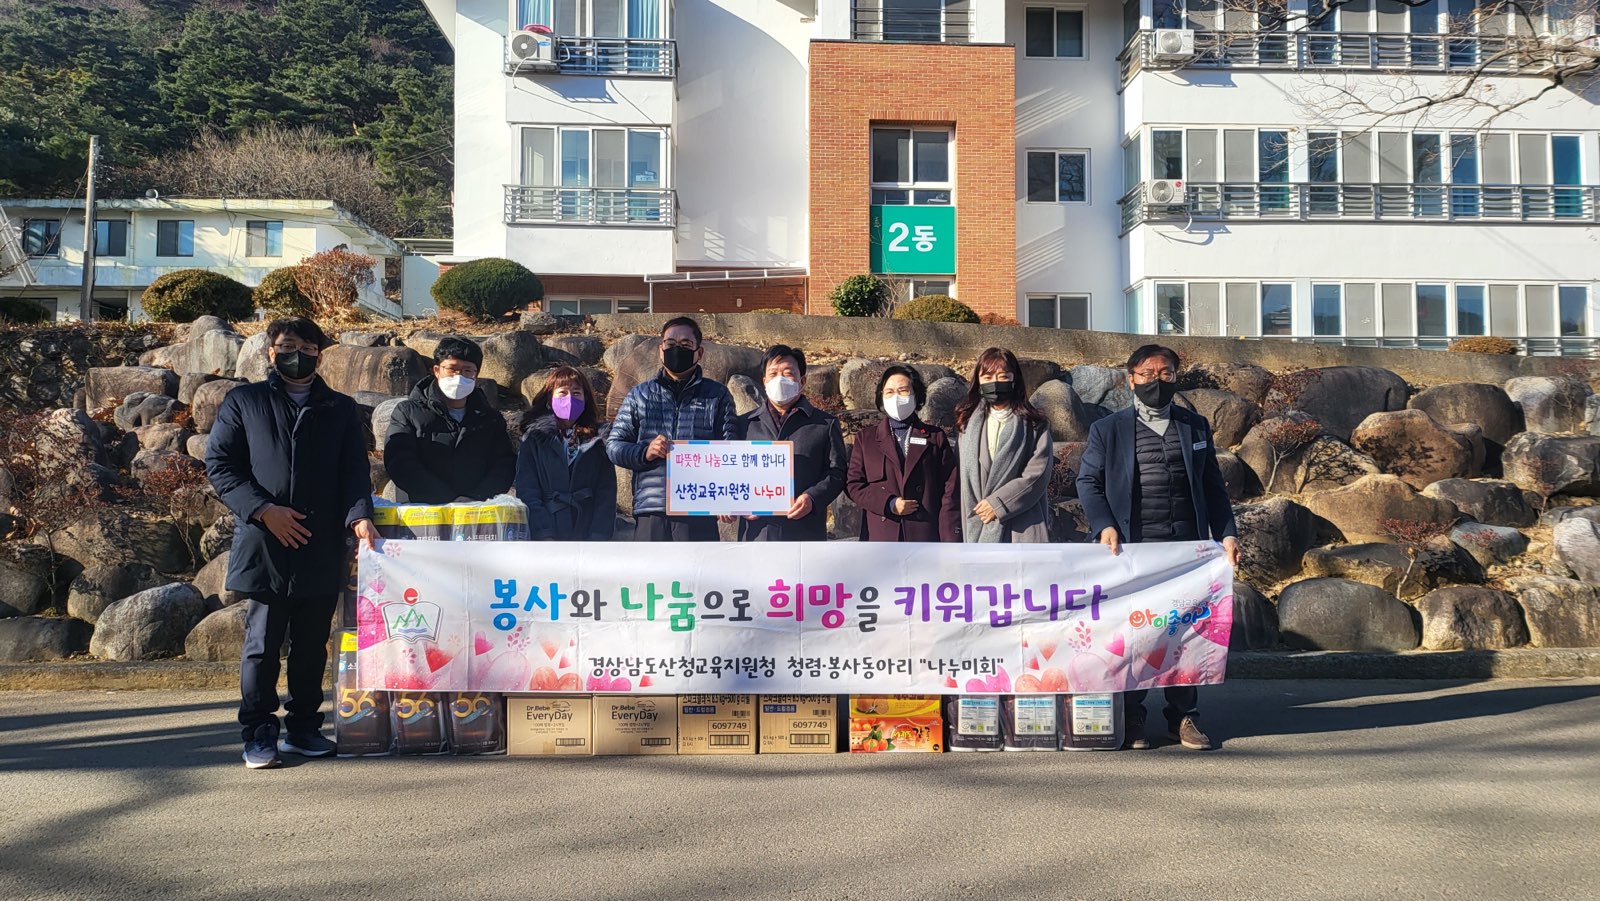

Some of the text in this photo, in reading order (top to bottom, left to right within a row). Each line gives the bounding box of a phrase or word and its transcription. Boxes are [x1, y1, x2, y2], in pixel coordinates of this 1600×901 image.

[888, 222, 937, 252] 2동
[675, 453, 786, 468] 따뜻한 나눔으로 함께 합니다
[675, 482, 785, 501] 산청교육지원청 나누미
[490, 579, 1108, 632] 봉사와 나눔으로 희망을 키워갑니다
[1129, 606, 1210, 636] 아이좋아
[588, 656, 776, 679] 경상남도산청교육지원청
[919, 656, 1004, 678] "나누미회"
[526, 711, 573, 722] EveryDay
[611, 711, 658, 721] EveryDay
